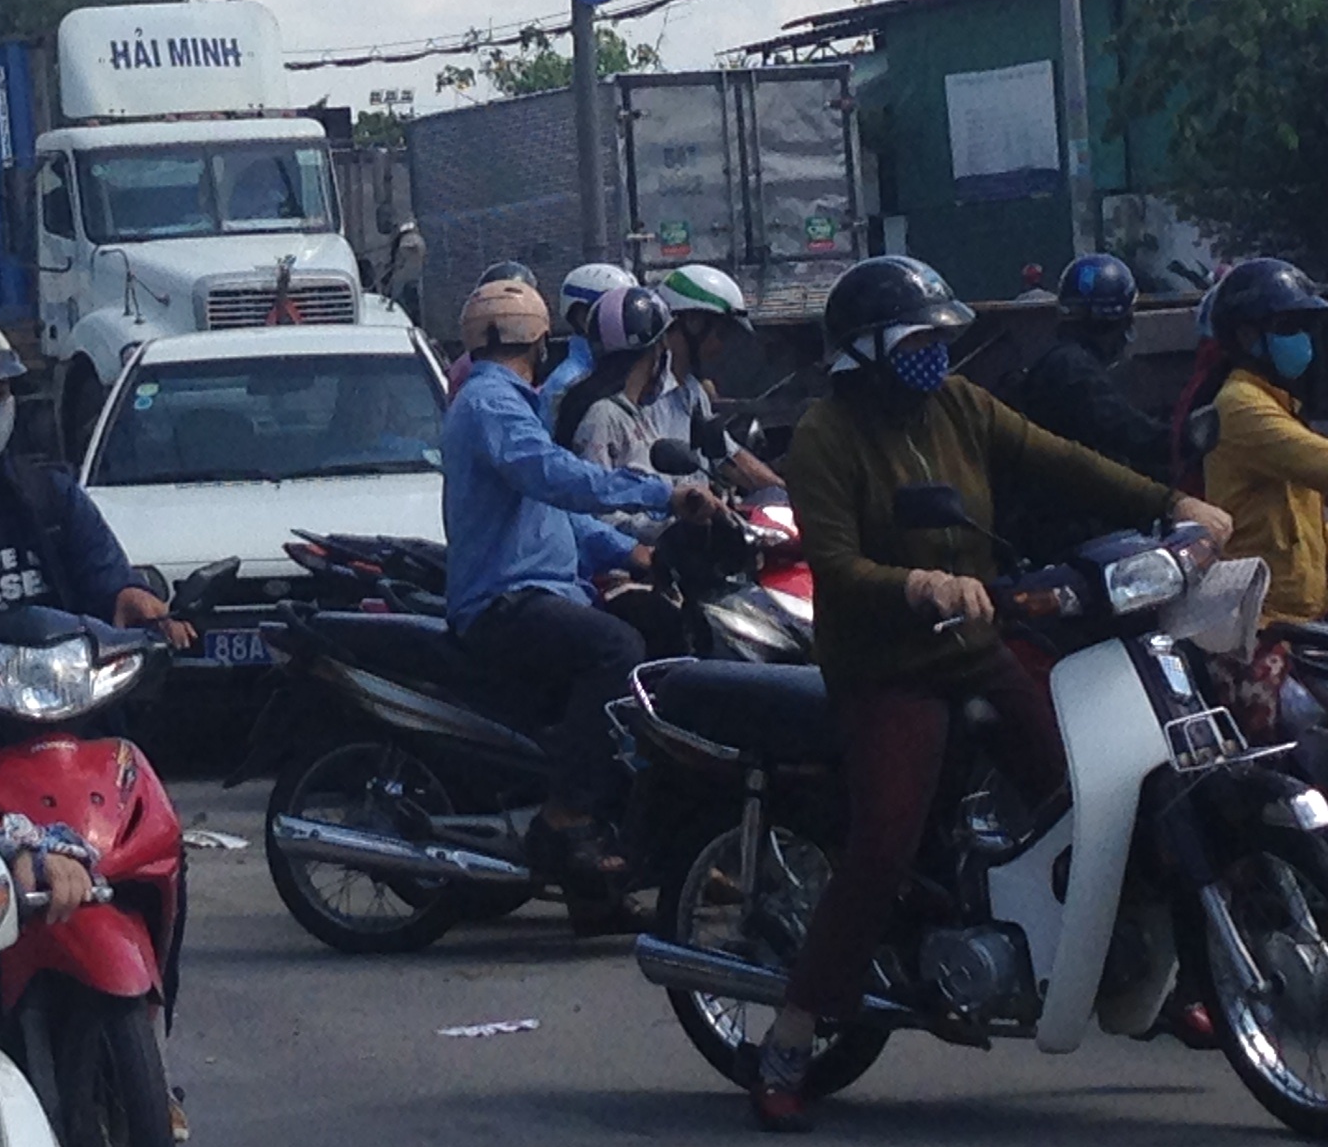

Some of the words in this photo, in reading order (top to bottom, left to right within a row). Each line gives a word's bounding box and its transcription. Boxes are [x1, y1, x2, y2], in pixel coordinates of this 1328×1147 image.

[110, 26, 162, 70] HẢI
[167, 37, 242, 67] MINH
[214, 634, 265, 661] 88A
